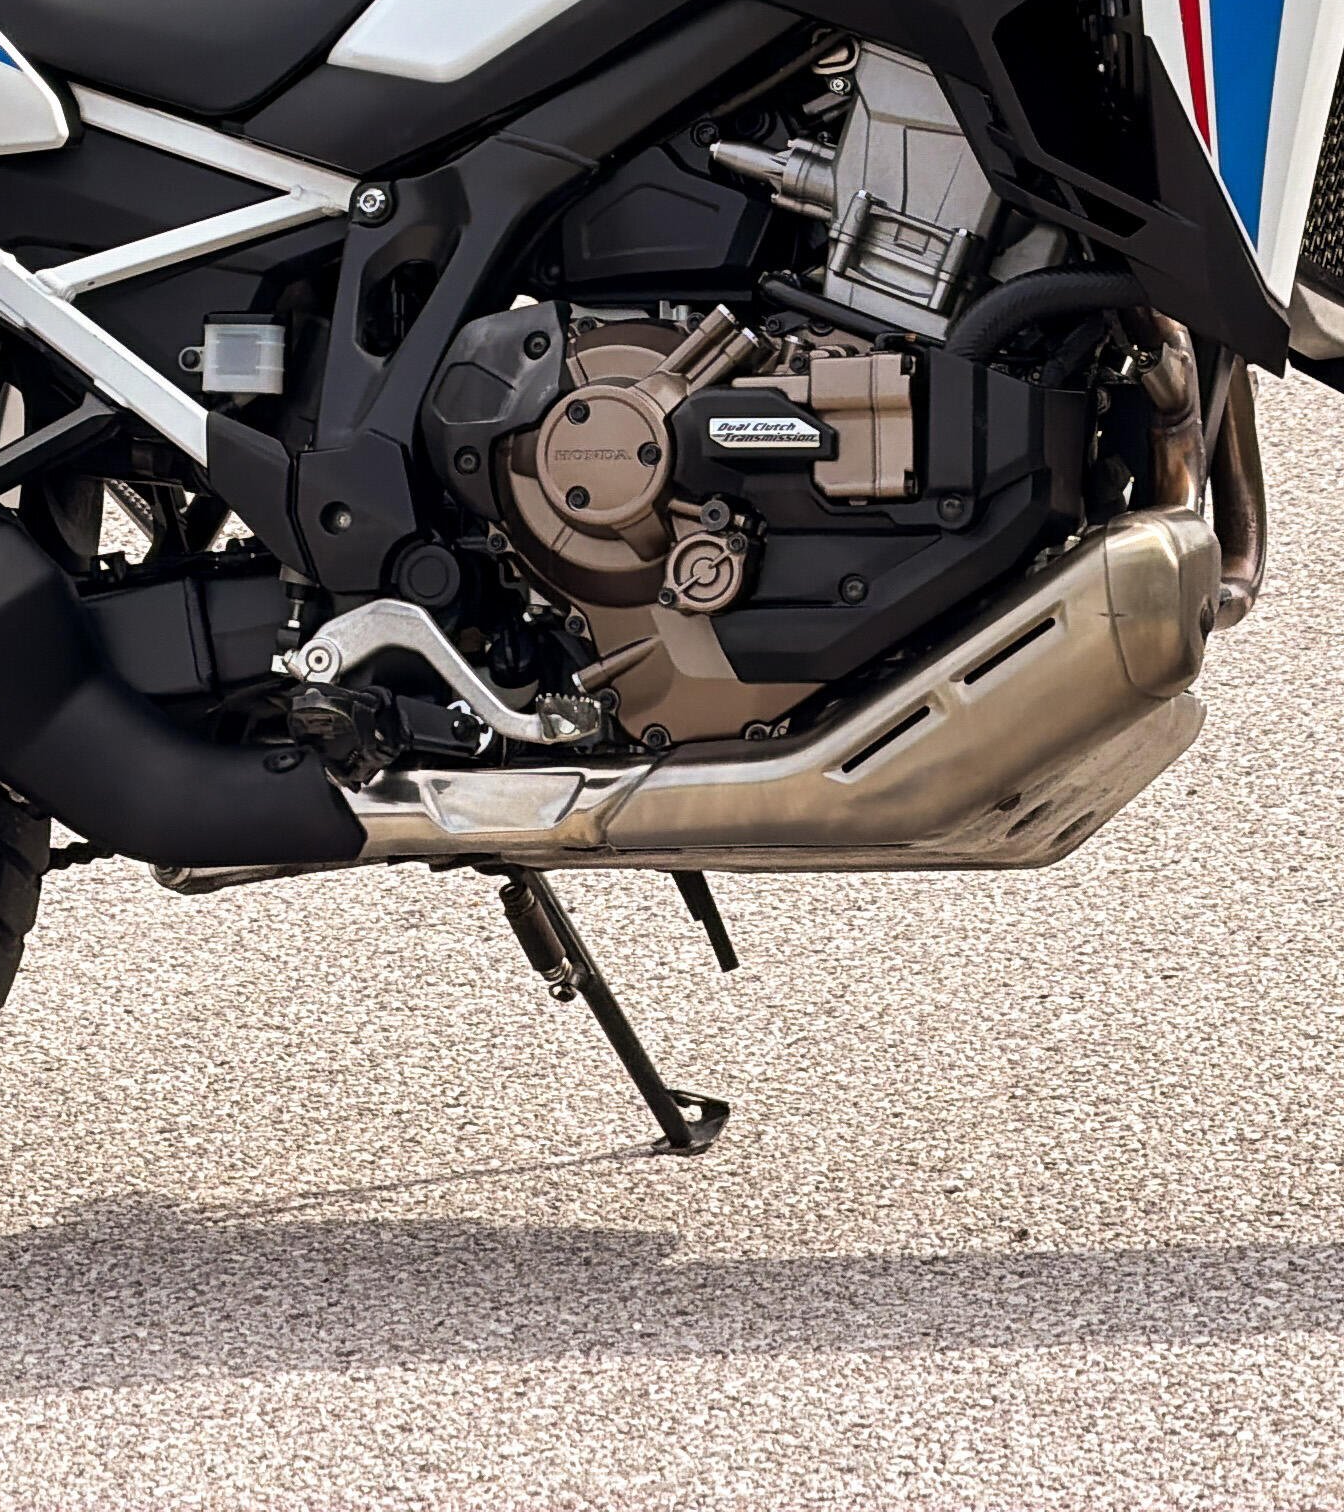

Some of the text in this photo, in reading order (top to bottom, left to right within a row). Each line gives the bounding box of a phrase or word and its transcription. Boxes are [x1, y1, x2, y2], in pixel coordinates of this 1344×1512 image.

[716, 422, 797, 432] Dual Clutch
[720, 431, 819, 444] Transmission
